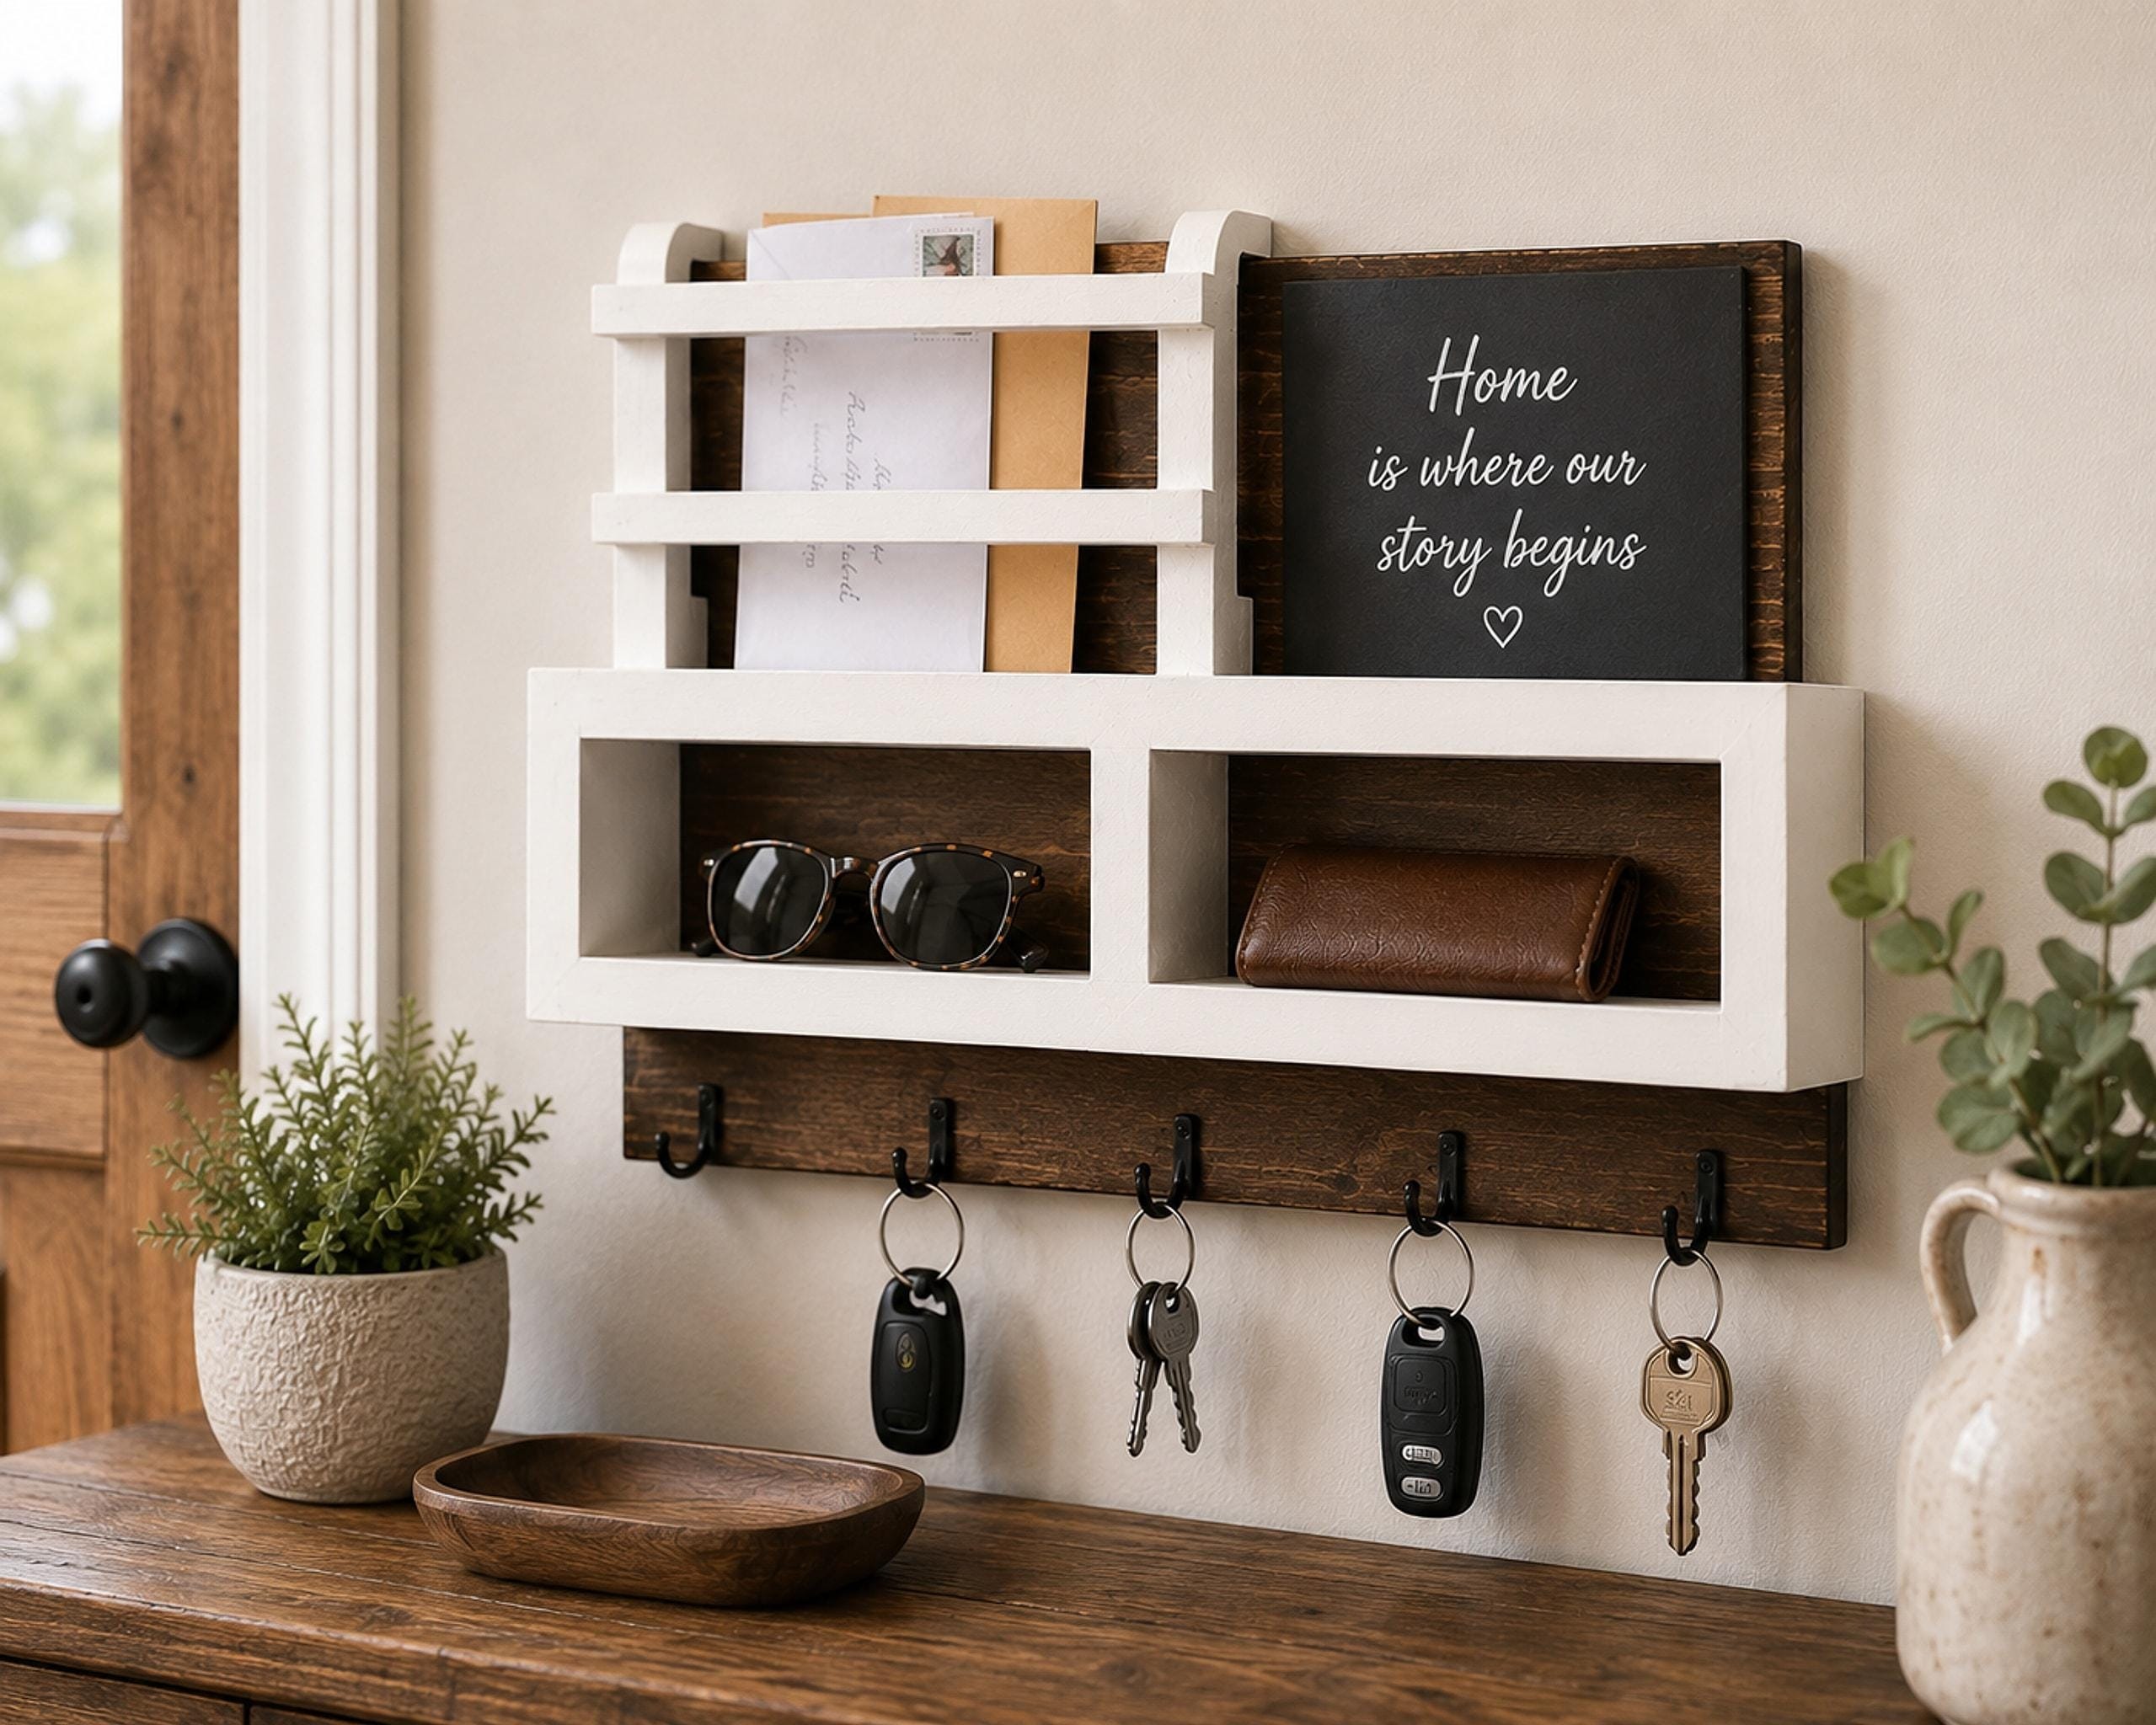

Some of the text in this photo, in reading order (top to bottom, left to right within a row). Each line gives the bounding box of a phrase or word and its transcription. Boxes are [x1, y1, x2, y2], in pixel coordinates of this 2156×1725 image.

[1427, 334, 1578, 416] Home
[1368, 427, 1647, 491] is where our
[1377, 508, 1647, 597] story begins
